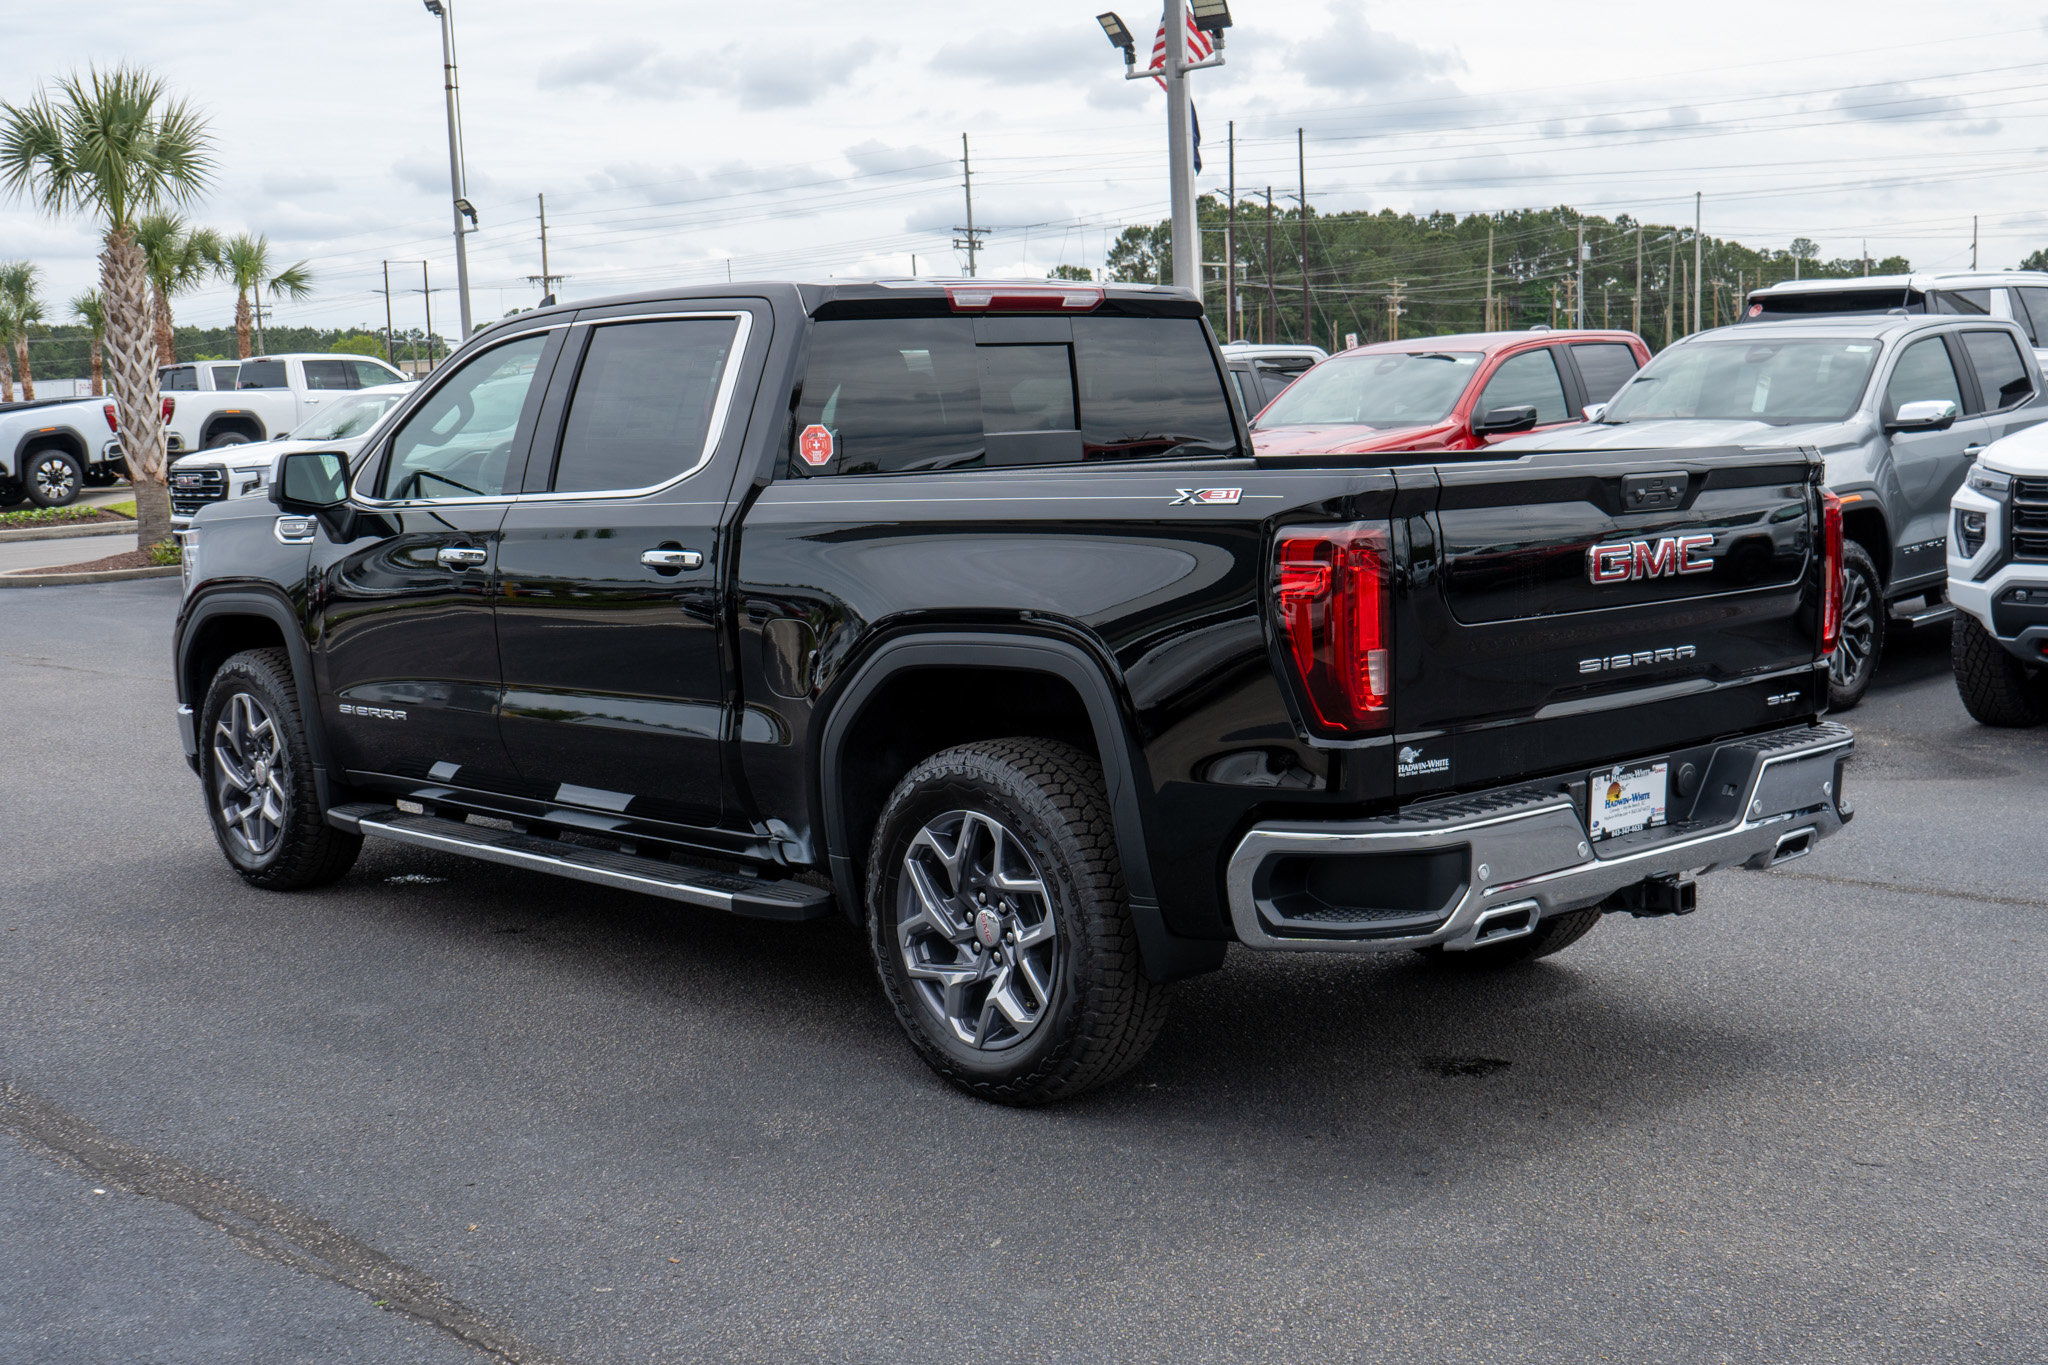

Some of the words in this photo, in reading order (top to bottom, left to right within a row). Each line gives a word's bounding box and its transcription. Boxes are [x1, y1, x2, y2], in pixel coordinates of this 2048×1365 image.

[1168, 487, 1243, 506] X31
[1588, 534, 1714, 585] GMC
[1578, 645, 1696, 674] SIERRA
[1767, 692, 1800, 706] SLT
[339, 704, 407, 720] SIERRA
[1398, 758, 1449, 773] HADWIN-WHITE
[1604, 792, 1650, 809] HADWIN-WHITE
[981, 912, 992, 942] GMC
